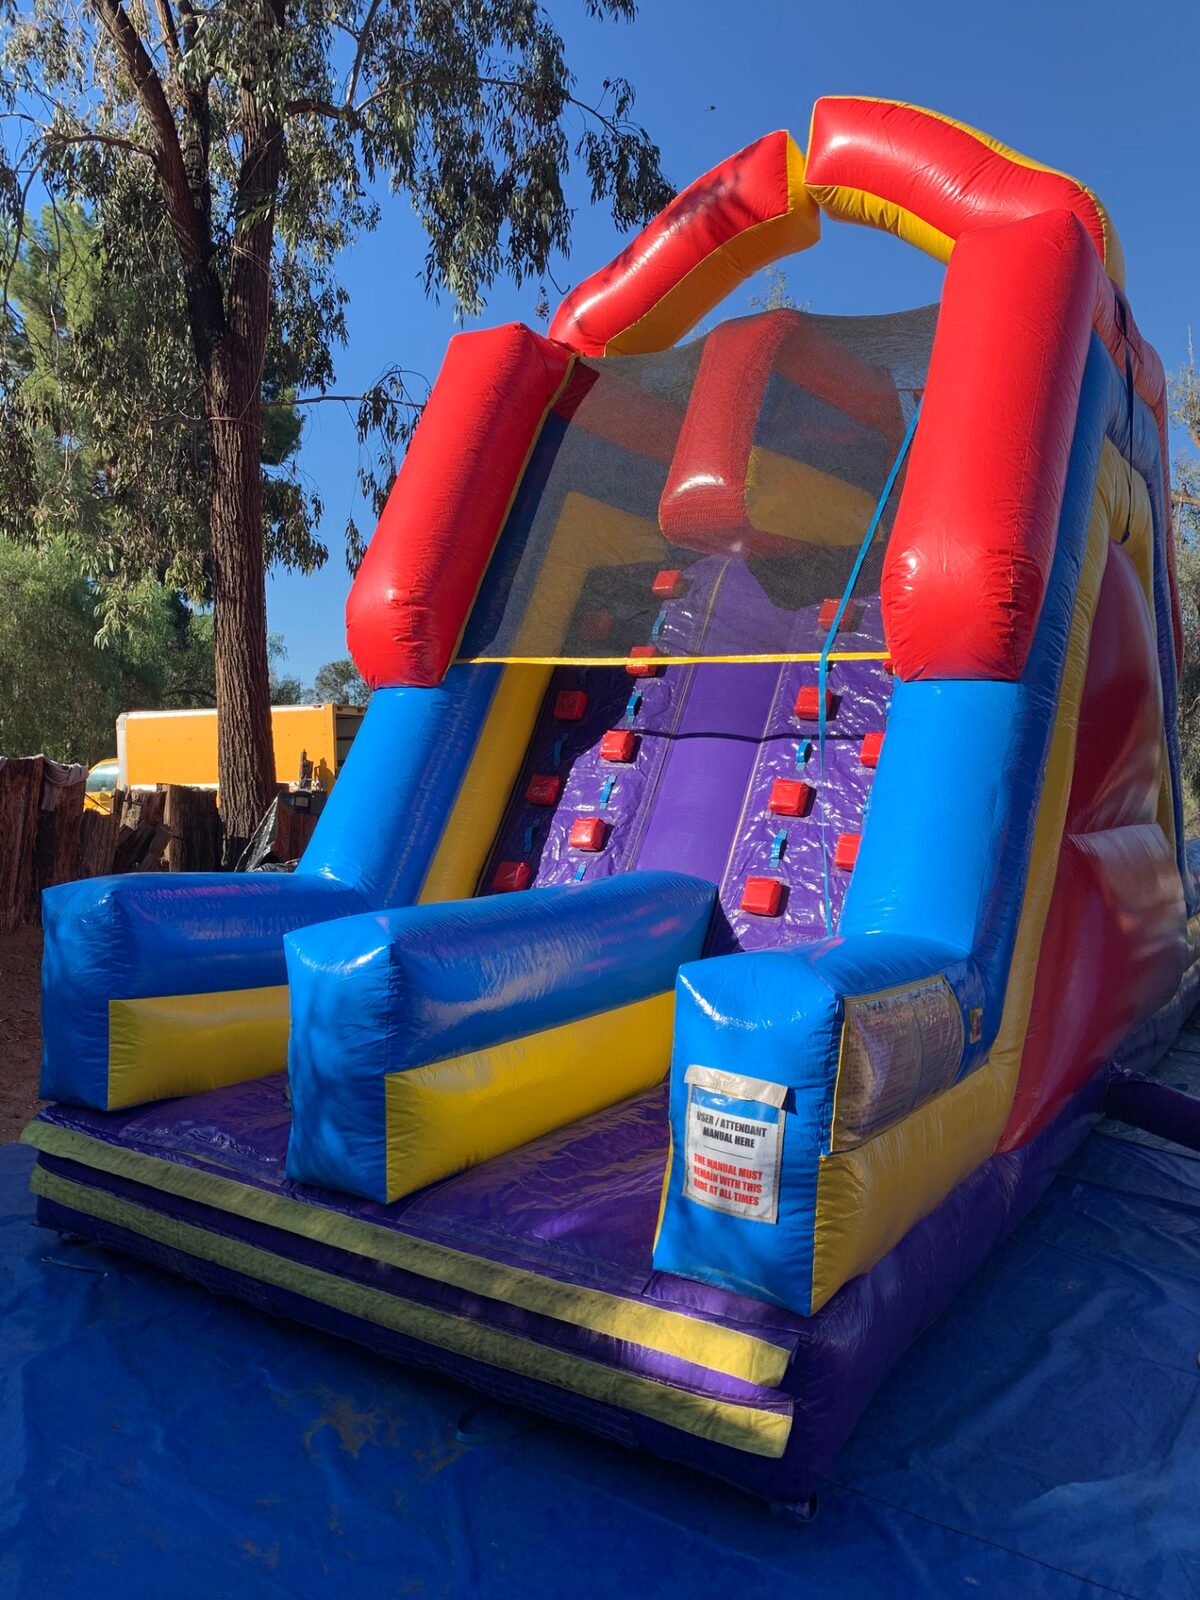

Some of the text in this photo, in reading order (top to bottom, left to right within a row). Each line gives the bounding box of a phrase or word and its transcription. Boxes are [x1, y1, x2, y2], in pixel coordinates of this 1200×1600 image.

[697, 1112, 768, 1137] USER / ATTENDANT
[703, 1127, 755, 1148] MANUAL HERE
[693, 1165, 763, 1194] REMAIN WITH THIS
[694, 1153, 763, 1181] THE MANUAL MUST
[693, 1178, 760, 1206] RIDE AT ALL TIMES
